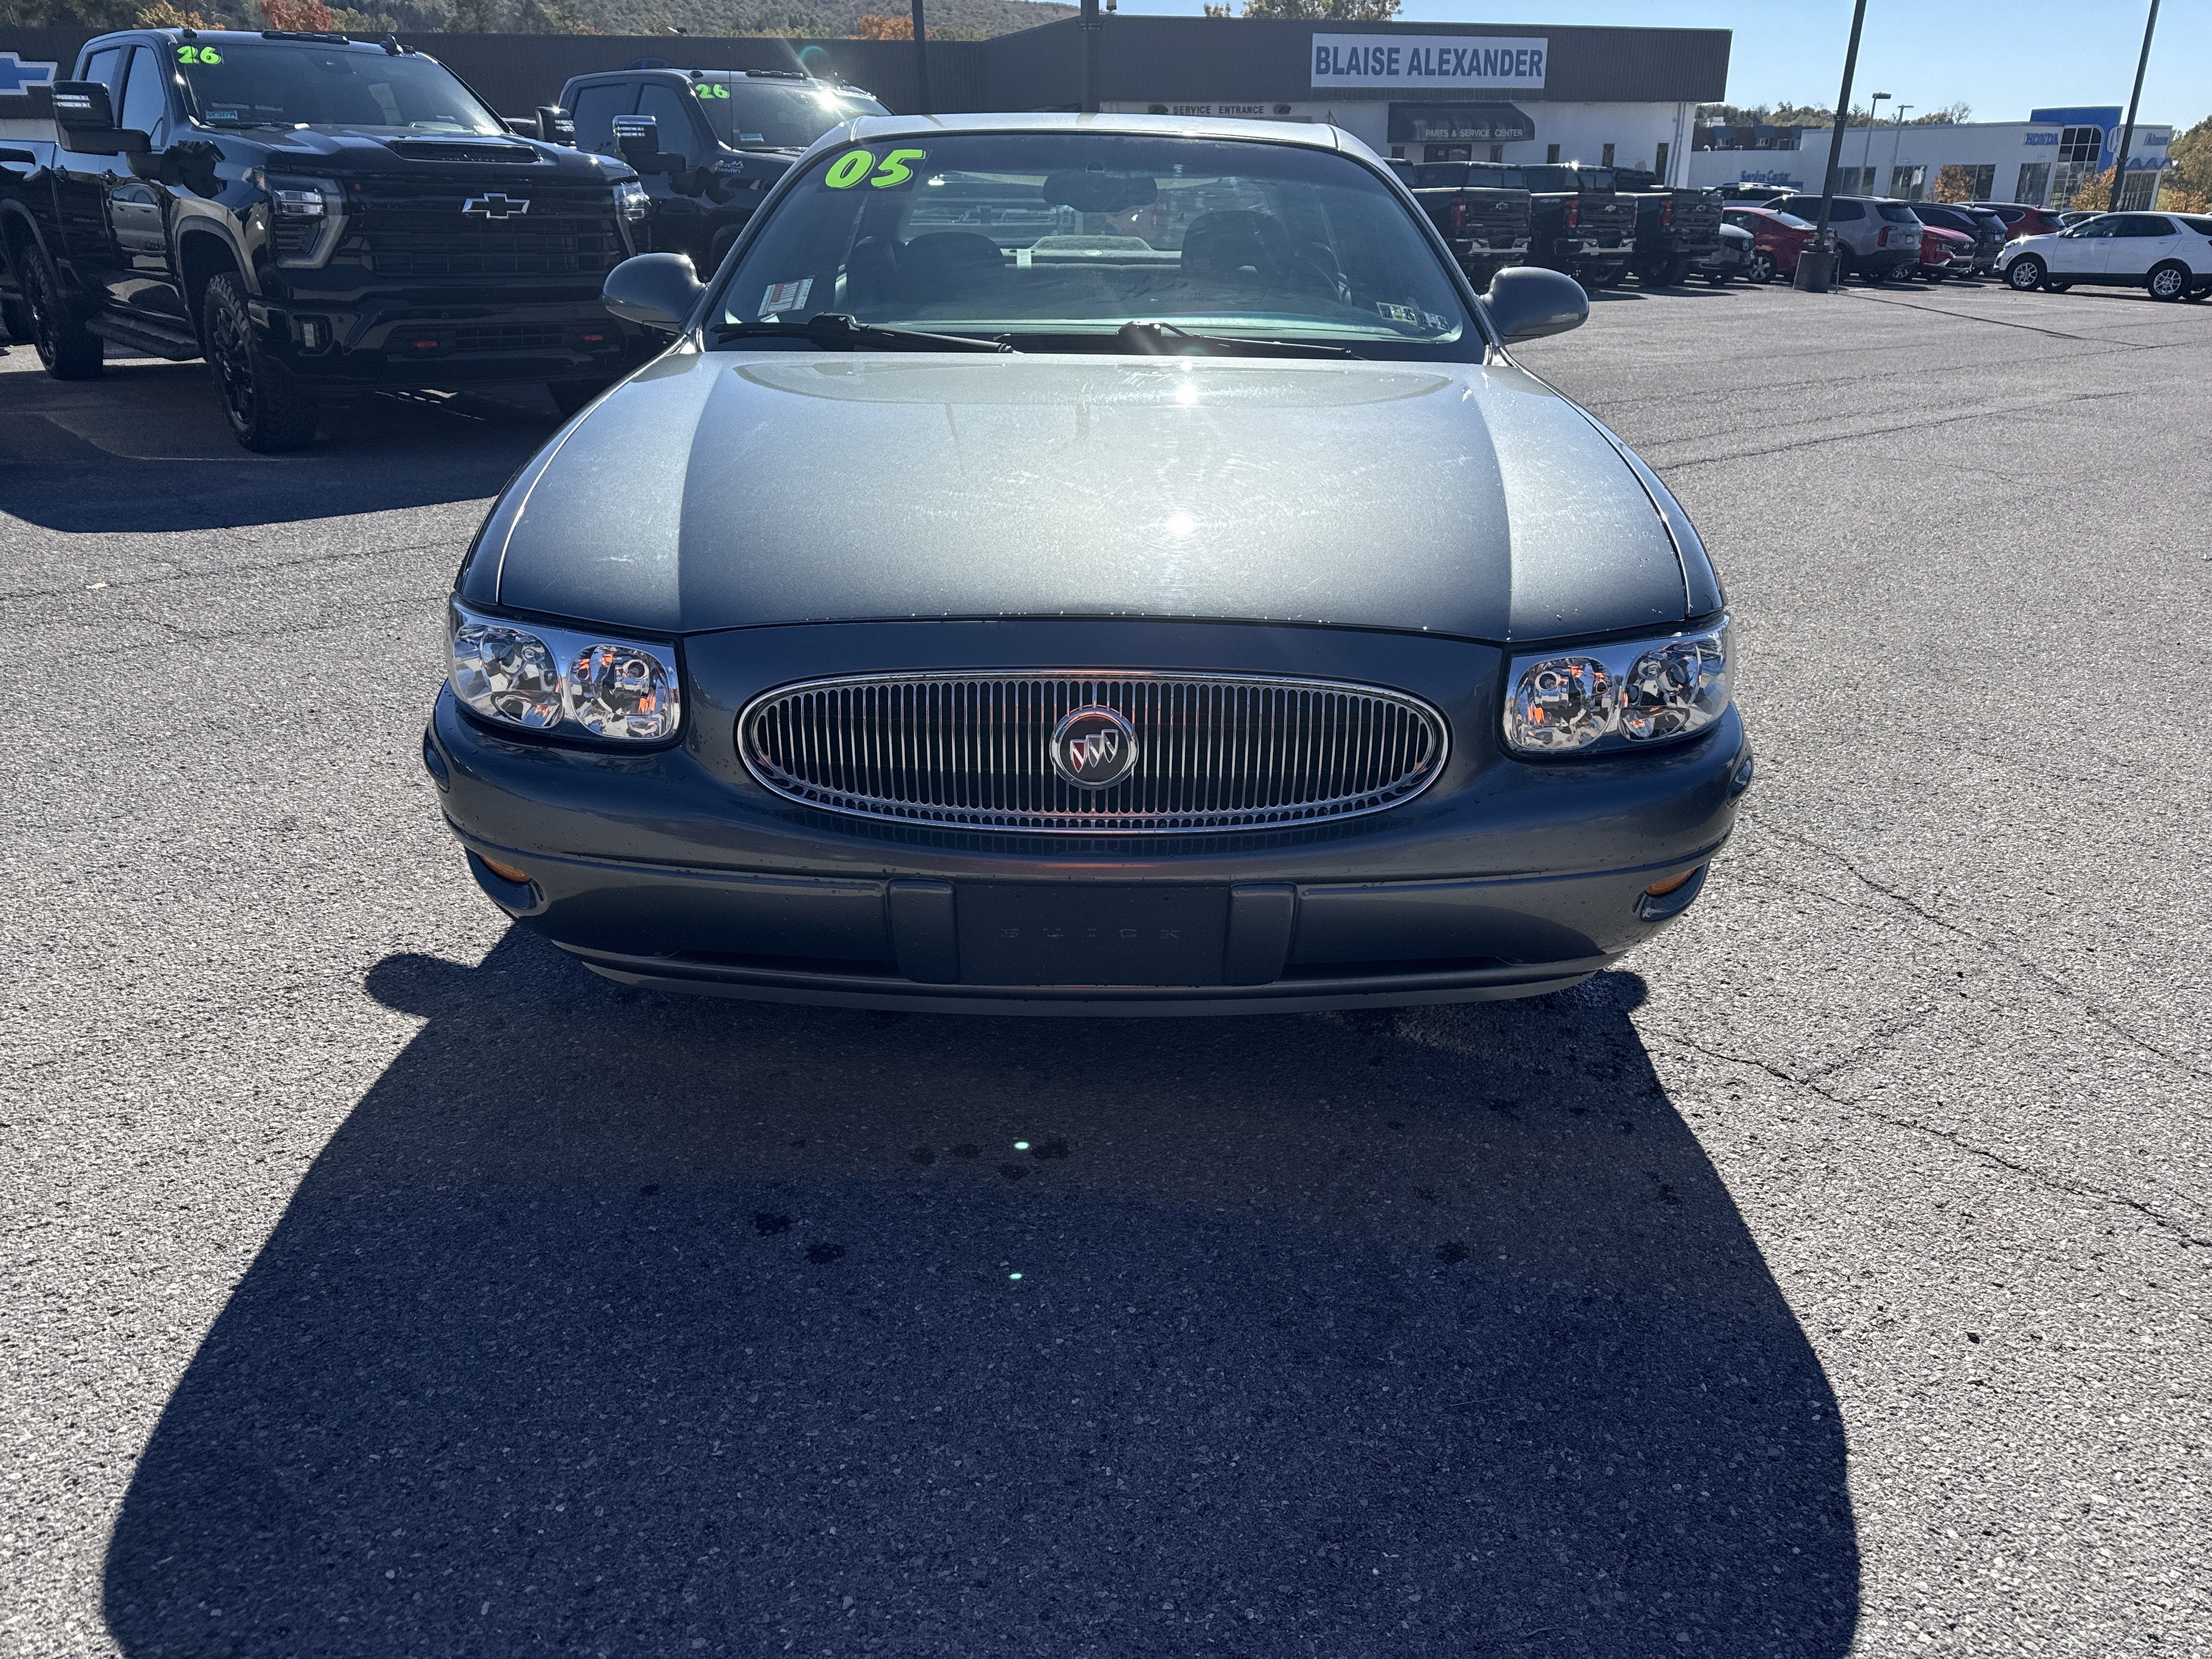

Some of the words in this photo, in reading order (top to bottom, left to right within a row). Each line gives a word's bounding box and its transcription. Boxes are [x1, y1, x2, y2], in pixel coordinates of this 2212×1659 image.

[177, 46, 222, 64] 26
[1316, 46, 1401, 76] BLAISE
[1407, 47, 1543, 77] ALEXANDER
[695, 84, 730, 99] 26
[1173, 105, 1211, 115] SERVICE
[1218, 105, 1265, 115] ENTRANCE
[1426, 129, 1449, 137] PARTS
[1451, 129, 1457, 137] &
[1459, 129, 1491, 137] SERVICE
[1494, 128, 1523, 137] CENTER
[2024, 132, 2059, 145] HONDA
[825, 149, 927, 189] 05
[1000, 928, 1180, 939] BUICK
